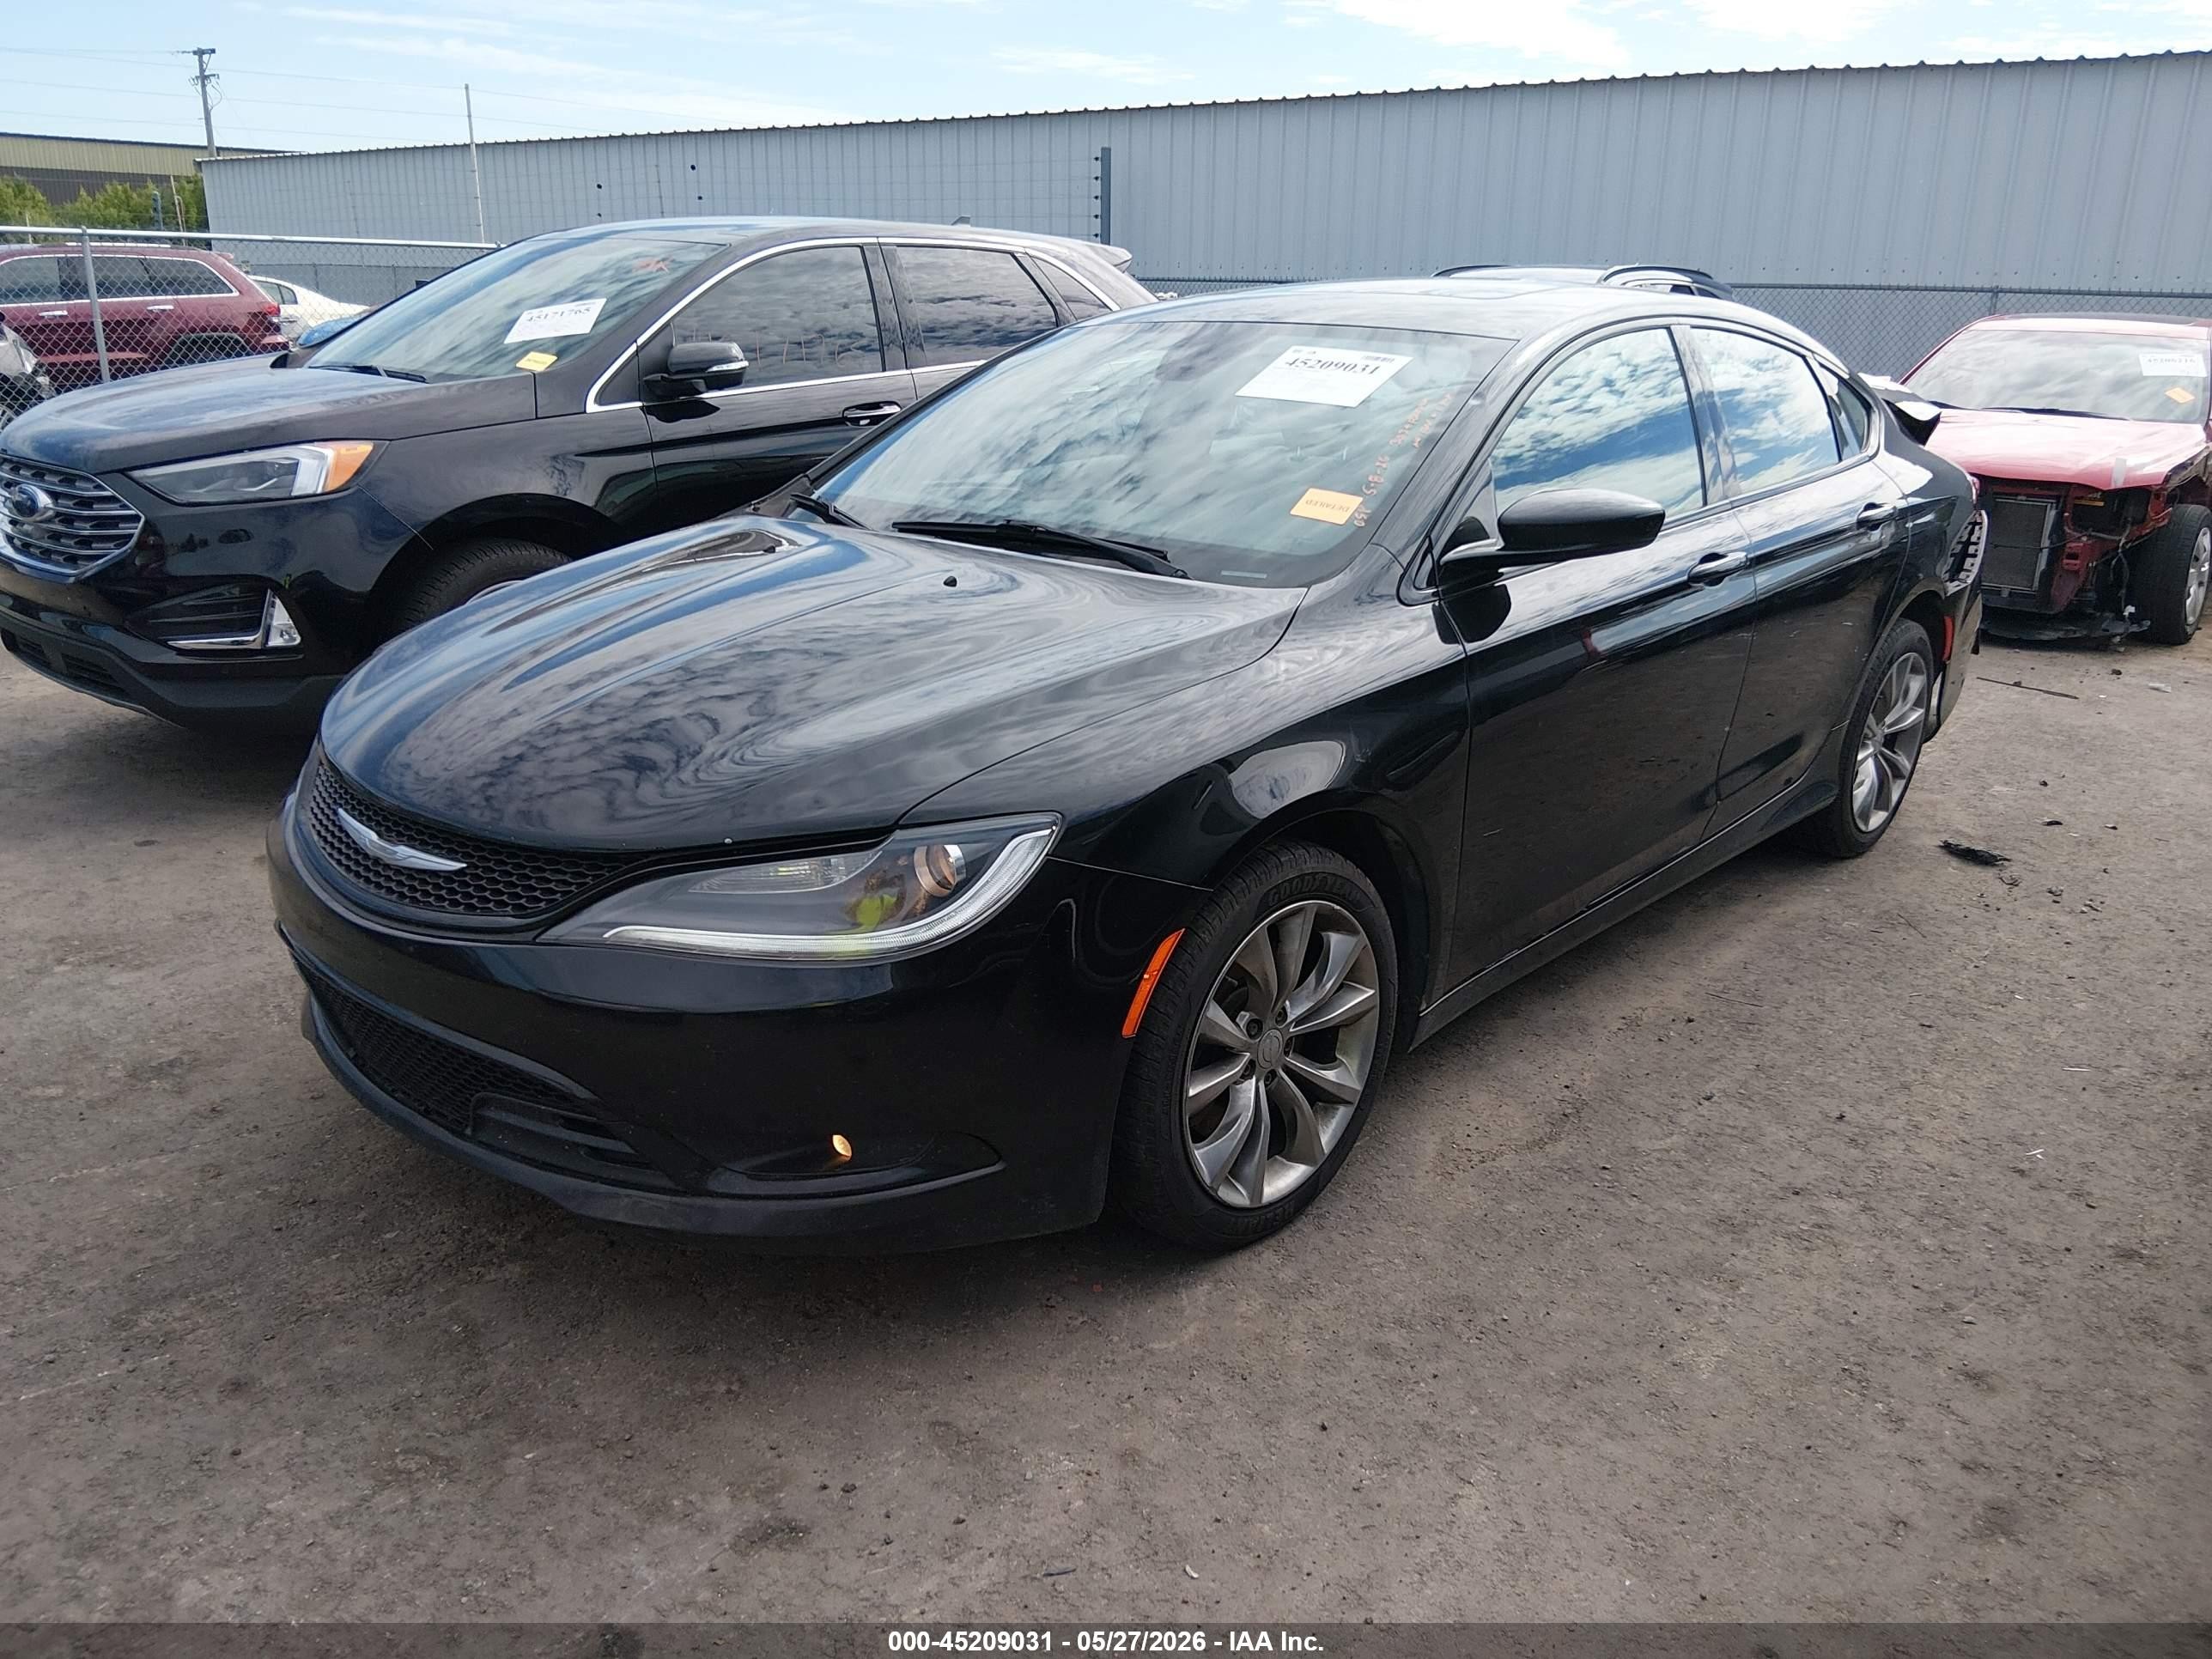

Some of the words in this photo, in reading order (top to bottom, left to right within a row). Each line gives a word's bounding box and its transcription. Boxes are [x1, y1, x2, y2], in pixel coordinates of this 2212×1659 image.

[1285, 357, 1381, 375] 45209031
[1305, 499, 1351, 514] DETAILED
[1268, 874, 1361, 905] GOODYEAR
